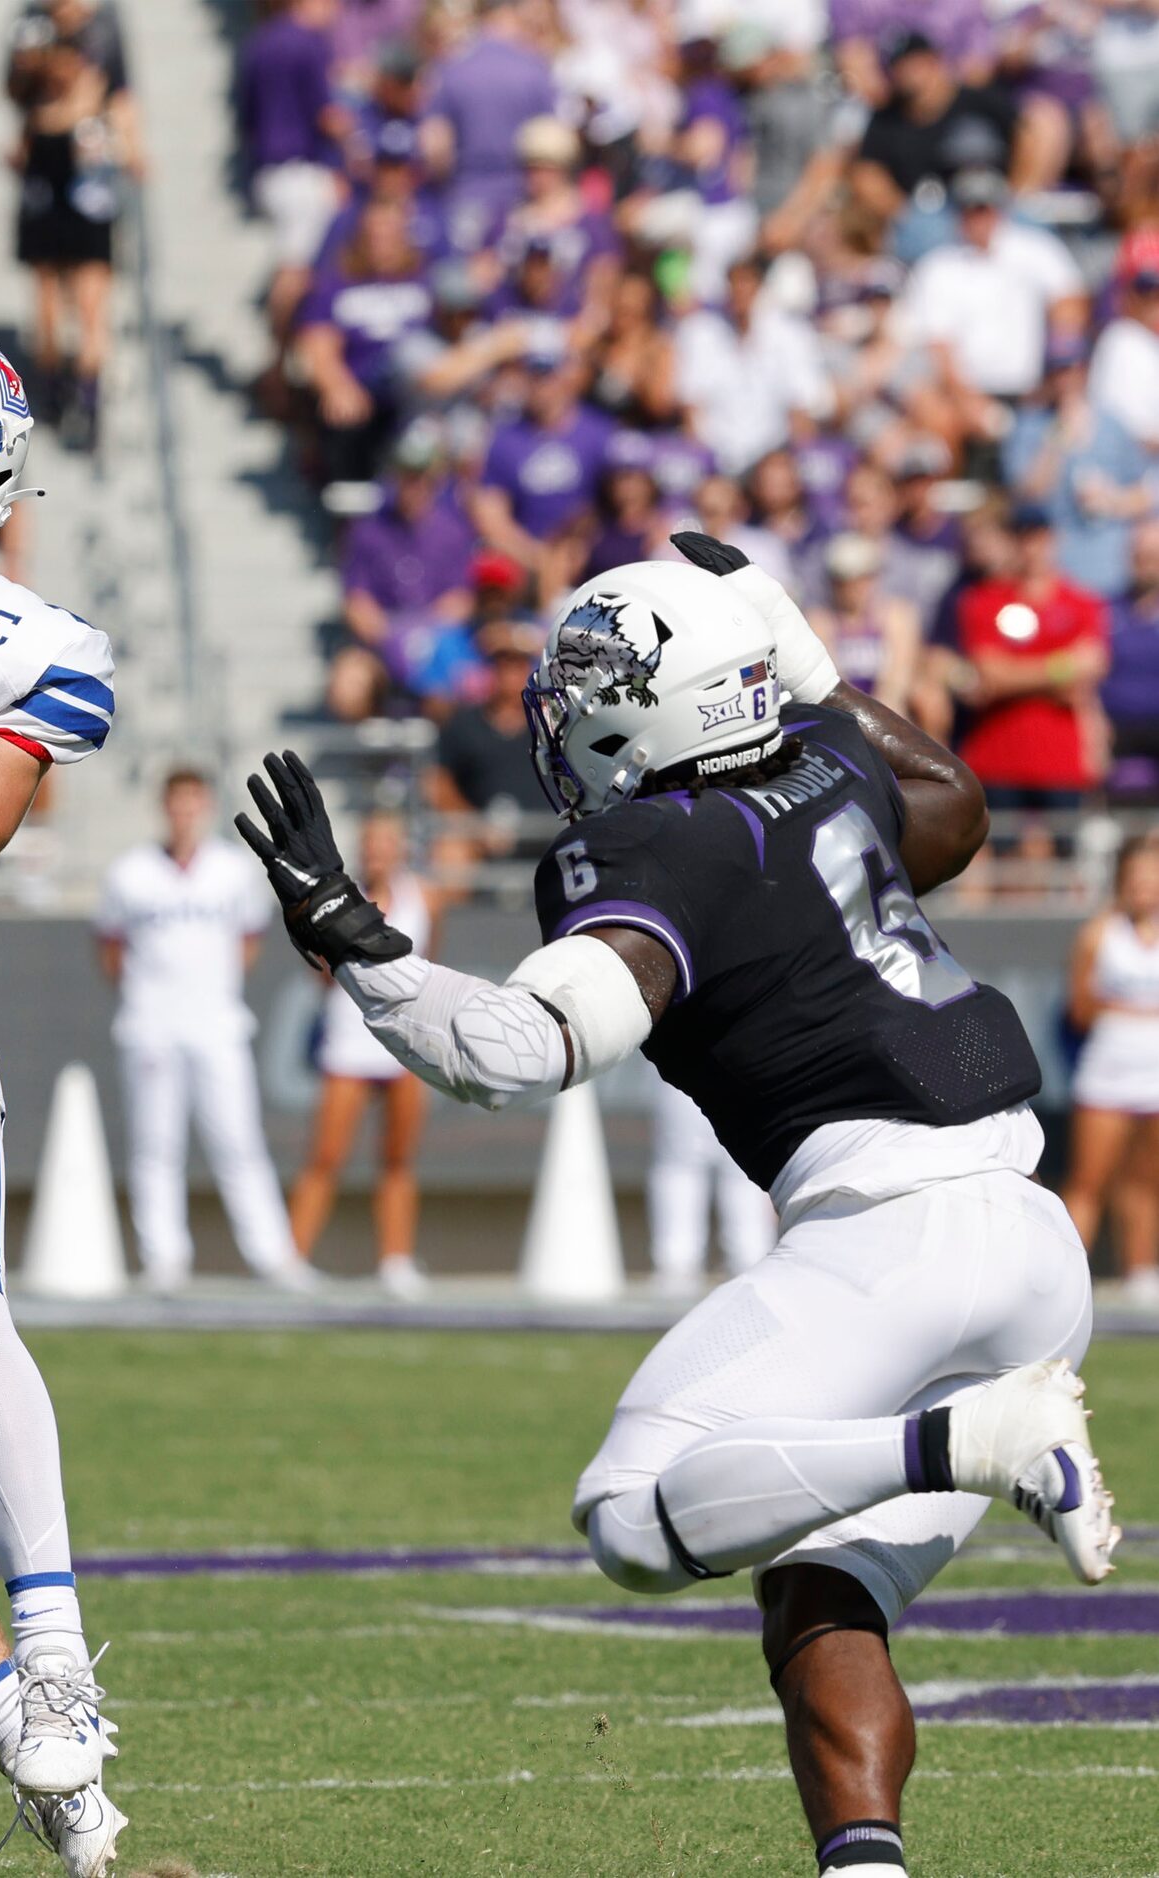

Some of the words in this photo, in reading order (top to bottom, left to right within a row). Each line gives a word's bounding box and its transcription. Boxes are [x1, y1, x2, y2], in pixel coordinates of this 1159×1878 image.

[753, 686, 766, 720] 6
[697, 747, 761, 775] HORNED
[555, 839, 598, 903] 6
[810, 800, 978, 1011] 6
